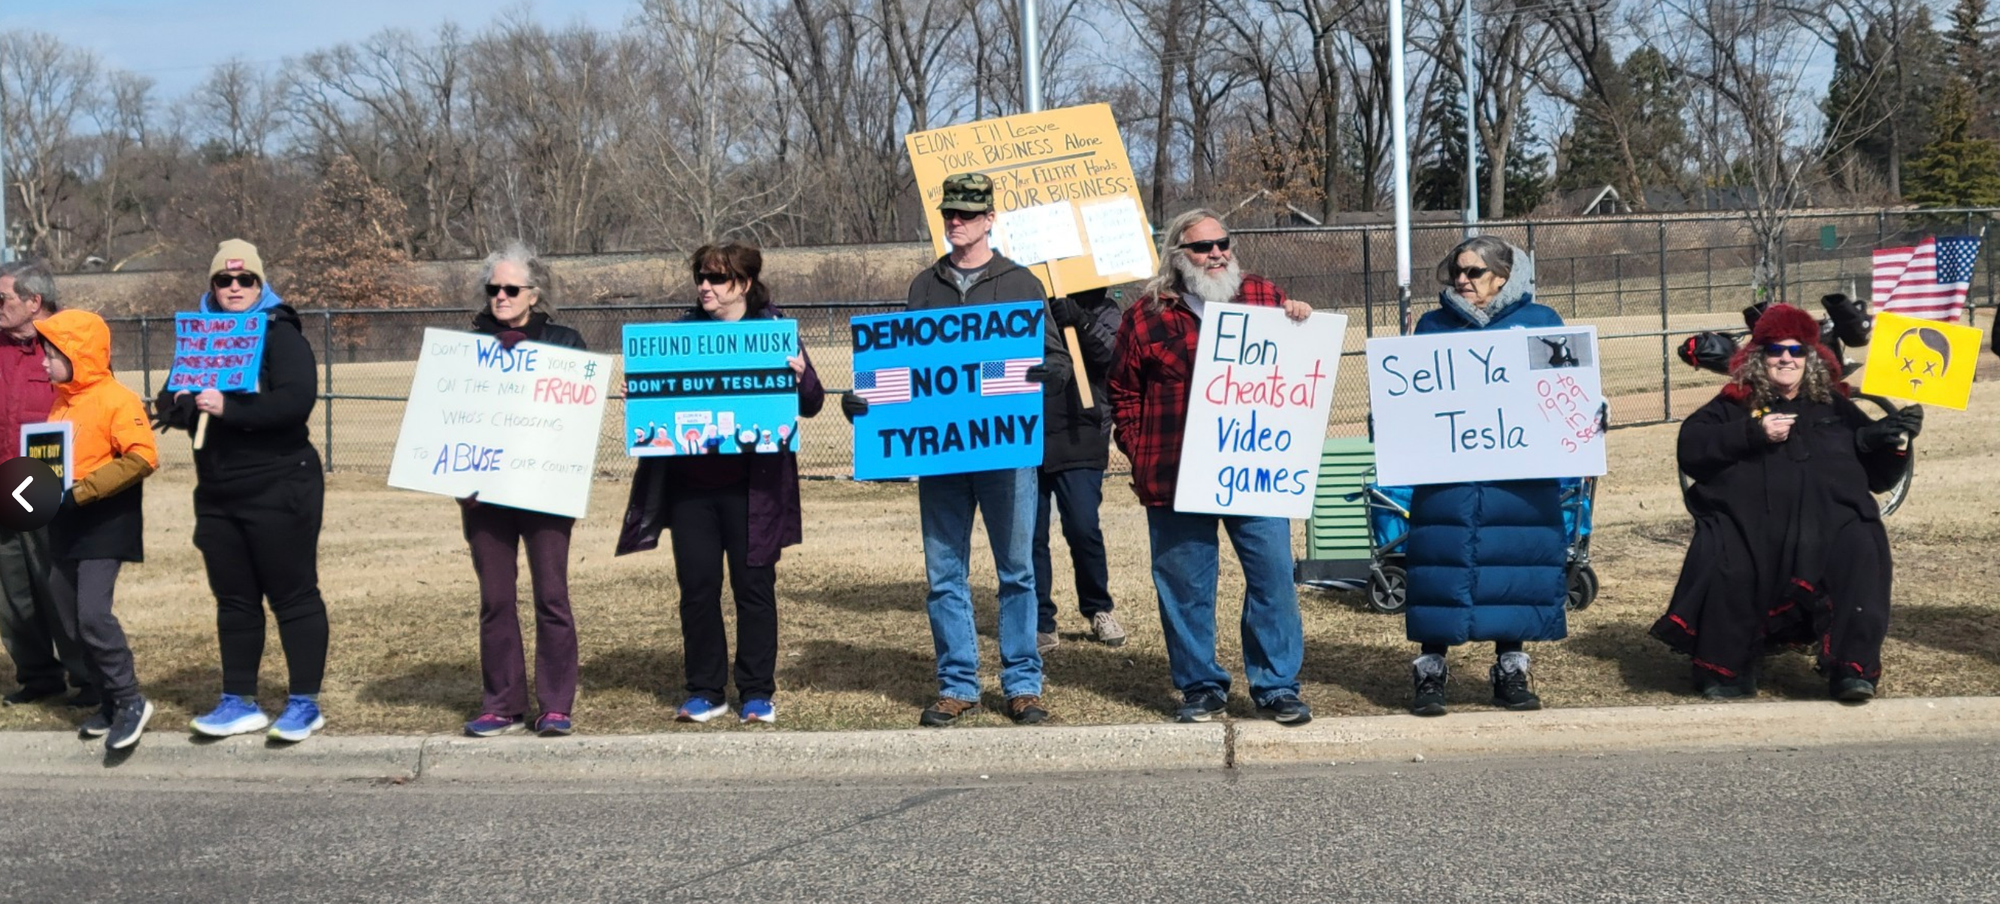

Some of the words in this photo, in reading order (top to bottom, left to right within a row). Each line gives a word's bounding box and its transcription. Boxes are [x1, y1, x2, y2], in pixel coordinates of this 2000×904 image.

[914, 131, 959, 155] ELON:
[971, 123, 1002, 144] I'll
[1006, 121, 1060, 138] Leave
[937, 151, 980, 173] YOUR
[983, 138, 1053, 165] BUSINESS
[1065, 133, 1102, 150] Alone
[1032, 163, 1077, 184] FILTHY
[1084, 159, 1117, 176] Hands
[1003, 187, 1043, 213] OUR
[1047, 177, 1133, 203] BUSINESS:
[178, 318, 236, 334] TRUMP
[244, 317, 258, 330] IS
[851, 308, 1045, 354] DEMOCRACY
[1213, 311, 1278, 365] Elon
[177, 336, 208, 351] THE
[213, 335, 260, 350] WORST
[431, 342, 470, 357] DON'T
[476, 339, 538, 373] WASTE
[547, 356, 577, 373] YOUR
[584, 359, 597, 380] $
[628, 335, 691, 358] DEFUND
[698, 334, 737, 355] ELON
[744, 332, 792, 353] MUSK
[174, 353, 254, 368] PRESIDENT
[1382, 347, 1456, 397] Sell
[1468, 345, 1510, 385] Ya
[170, 372, 217, 387] SINCE
[437, 377, 456, 393] ON
[464, 378, 490, 394] THE
[498, 382, 526, 396] NAZI
[533, 377, 597, 405] FRAUD
[628, 378, 676, 393] DON'T
[682, 377, 715, 391] BUY
[721, 374, 793, 390] TESLAS!
[912, 363, 980, 398] NOT
[1290, 359, 1326, 409] at
[1537, 379, 1551, 397] 0
[1556, 373, 1574, 389] to
[442, 409, 483, 425] WHO'S
[491, 411, 564, 431] CHOOSING
[1538, 385, 1589, 422] 1939
[878, 414, 1039, 458] TYRANNY
[1218, 409, 1291, 452] Video
[1434, 407, 1529, 453] Tesla
[1565, 412, 1587, 430] in
[432, 443, 504, 475] ABUSE
[510, 458, 536, 471] OUR
[1561, 437, 1577, 453] 3
[1216, 466, 1310, 506] games
